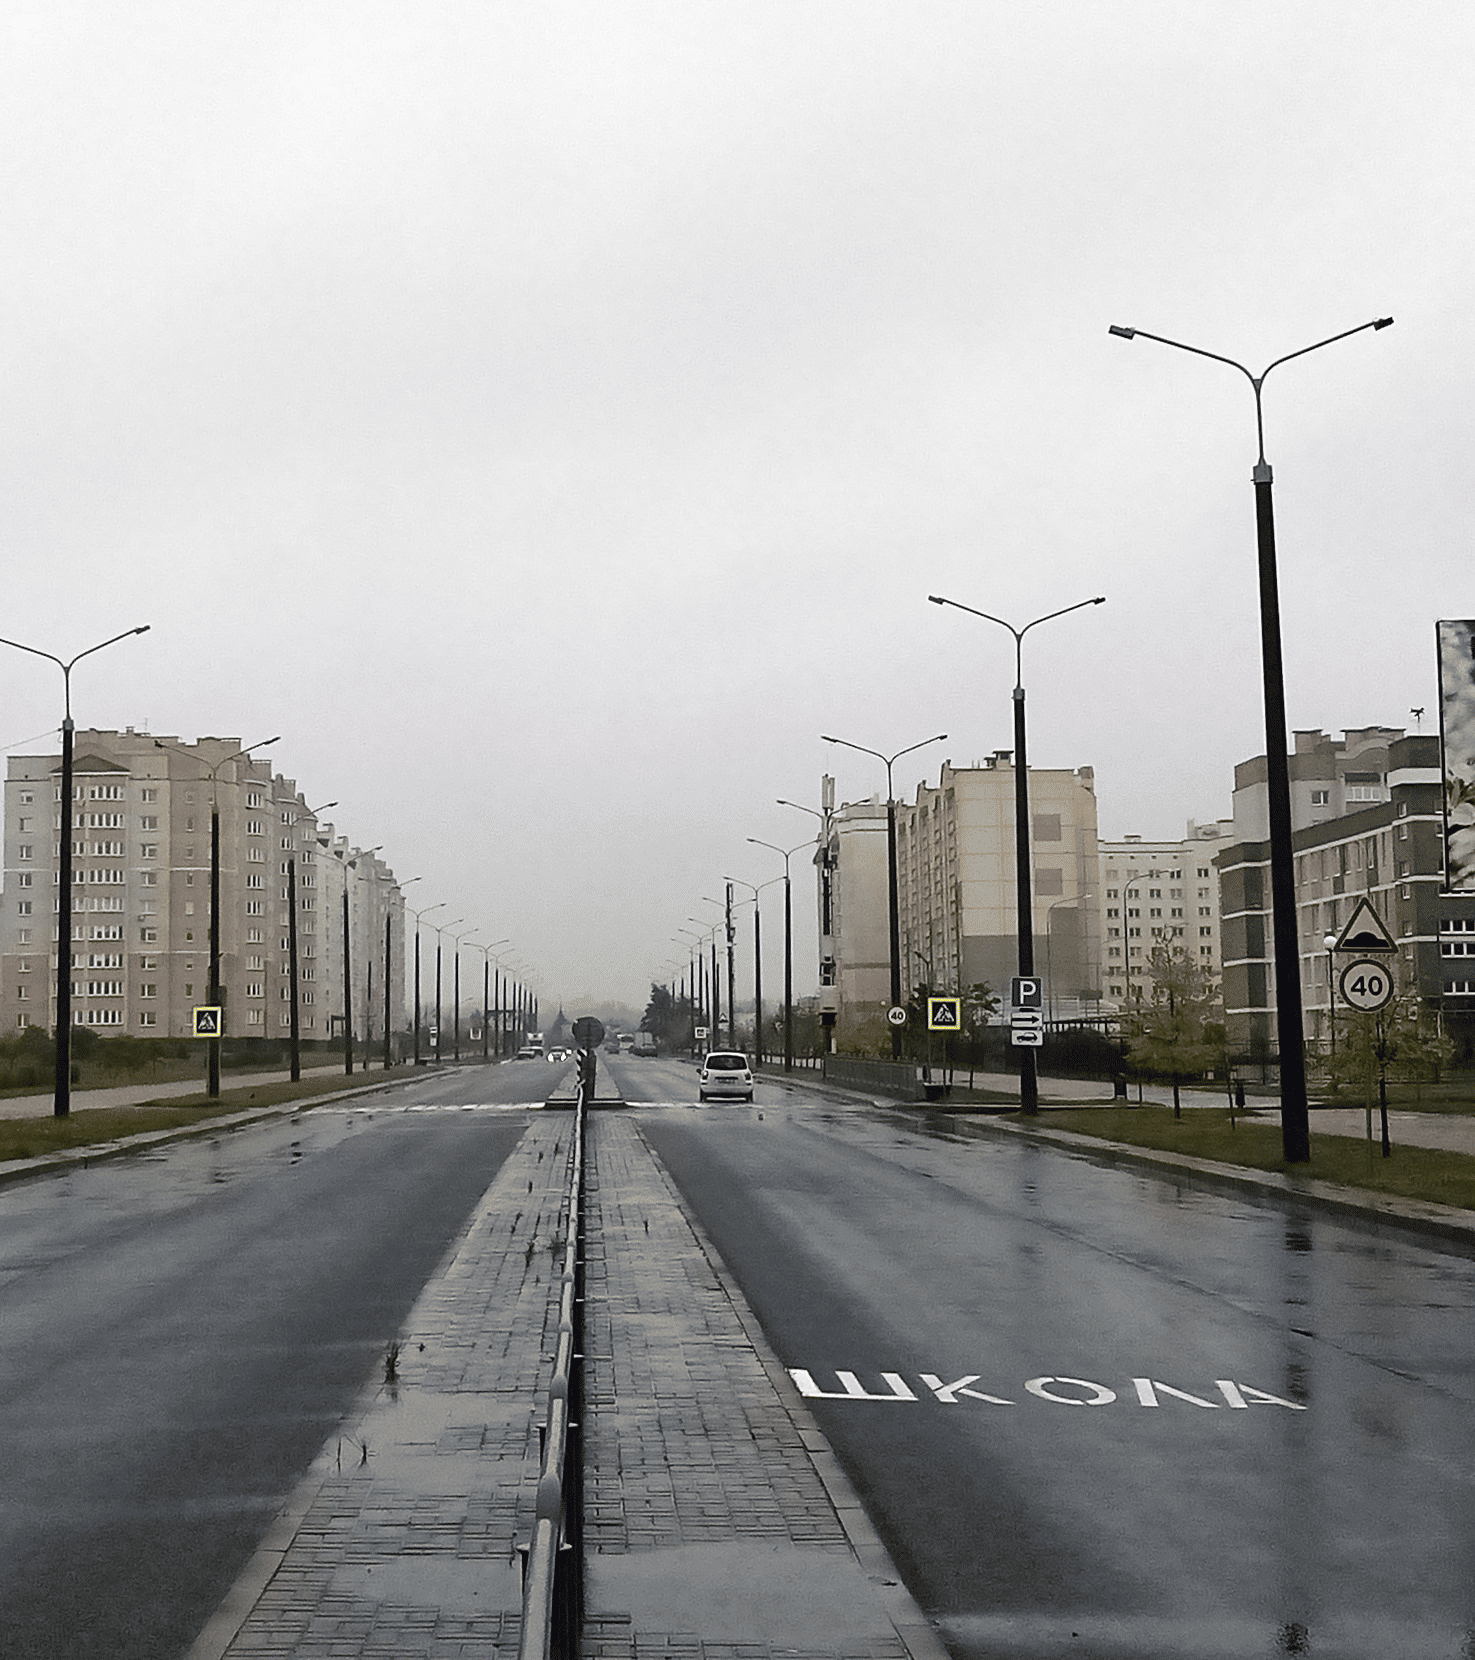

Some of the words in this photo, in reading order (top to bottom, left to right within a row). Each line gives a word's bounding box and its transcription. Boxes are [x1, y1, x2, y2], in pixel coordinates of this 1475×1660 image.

[1020, 980, 1037, 1005] P
[1350, 975, 1383, 997] 40
[891, 1011, 904, 1020] 40
[786, 1368, 1309, 1410] ШКОЛА
